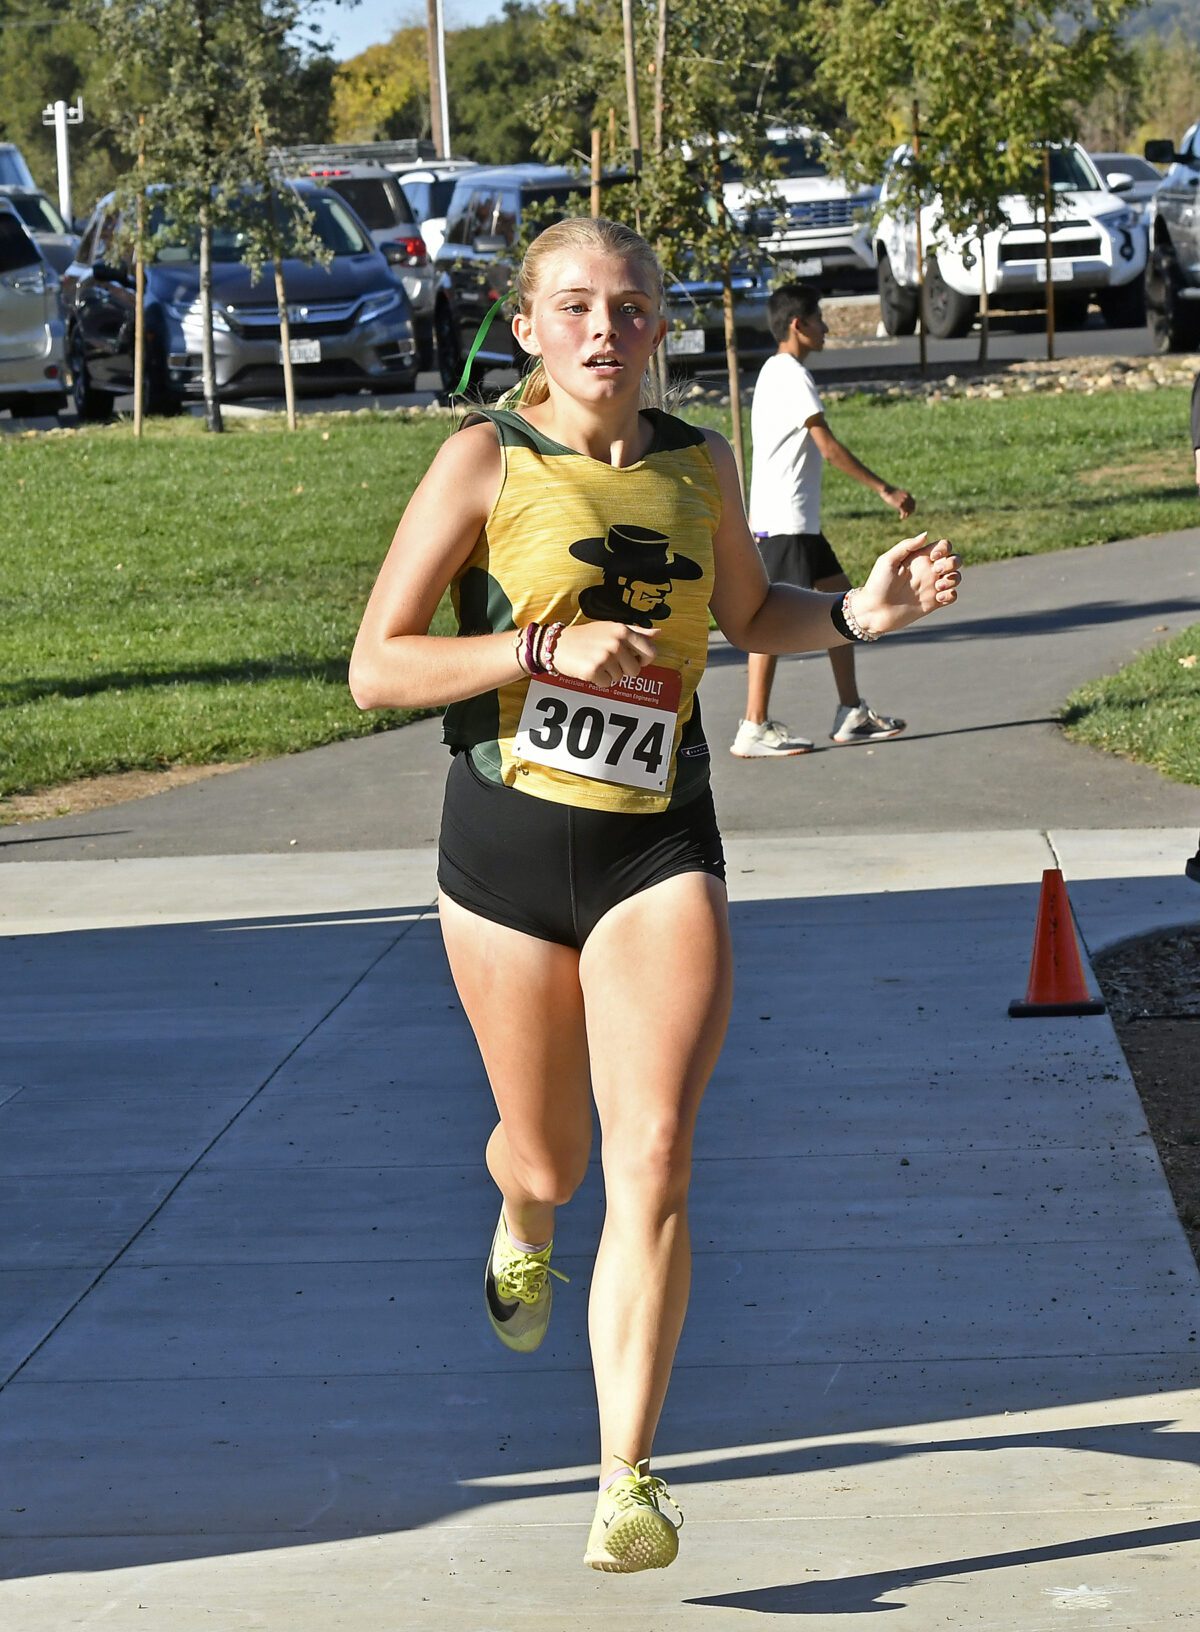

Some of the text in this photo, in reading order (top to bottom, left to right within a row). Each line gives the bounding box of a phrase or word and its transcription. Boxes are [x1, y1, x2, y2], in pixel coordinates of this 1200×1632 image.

[559, 677, 660, 705] Precision Passion German Engineering
[619, 674, 664, 695] RESULT
[528, 697, 666, 774] 3074
